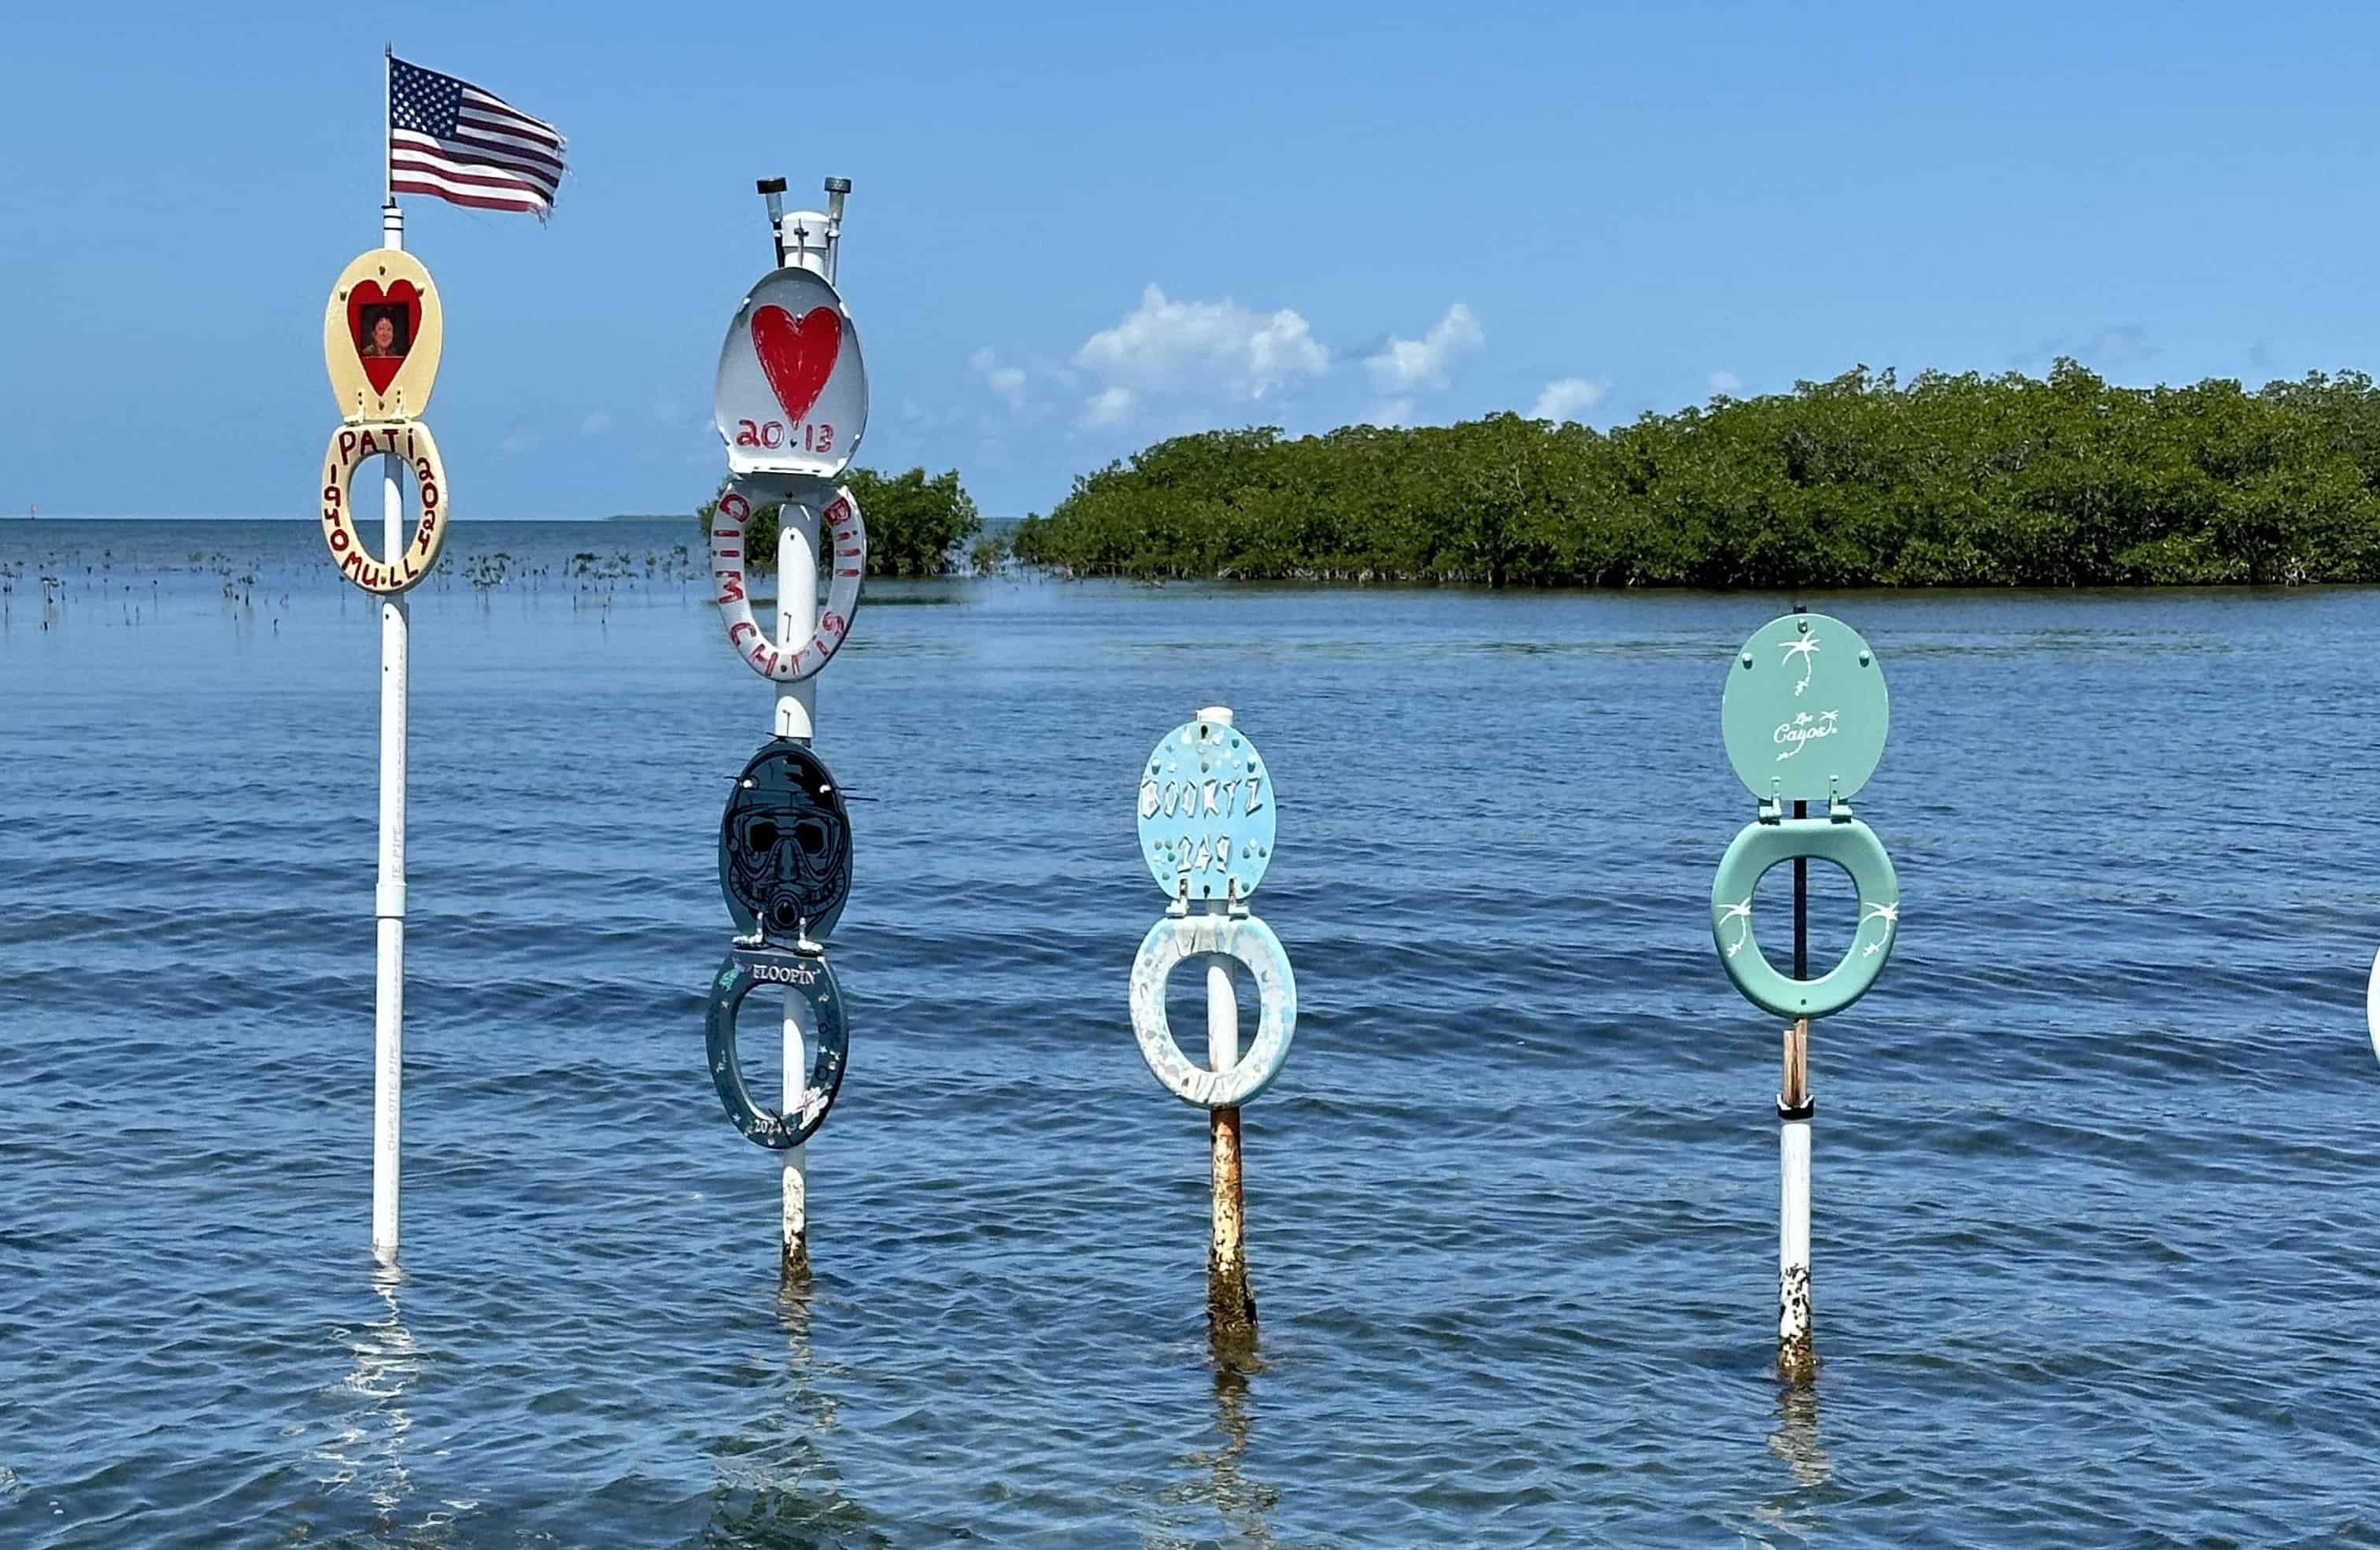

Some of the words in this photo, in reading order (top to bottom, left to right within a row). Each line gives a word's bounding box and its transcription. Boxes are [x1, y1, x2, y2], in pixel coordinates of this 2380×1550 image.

[736, 419, 835, 453] 2013
[323, 463, 349, 552] 1940
[416, 457, 439, 556] 2024
[342, 551, 419, 587] MULL
